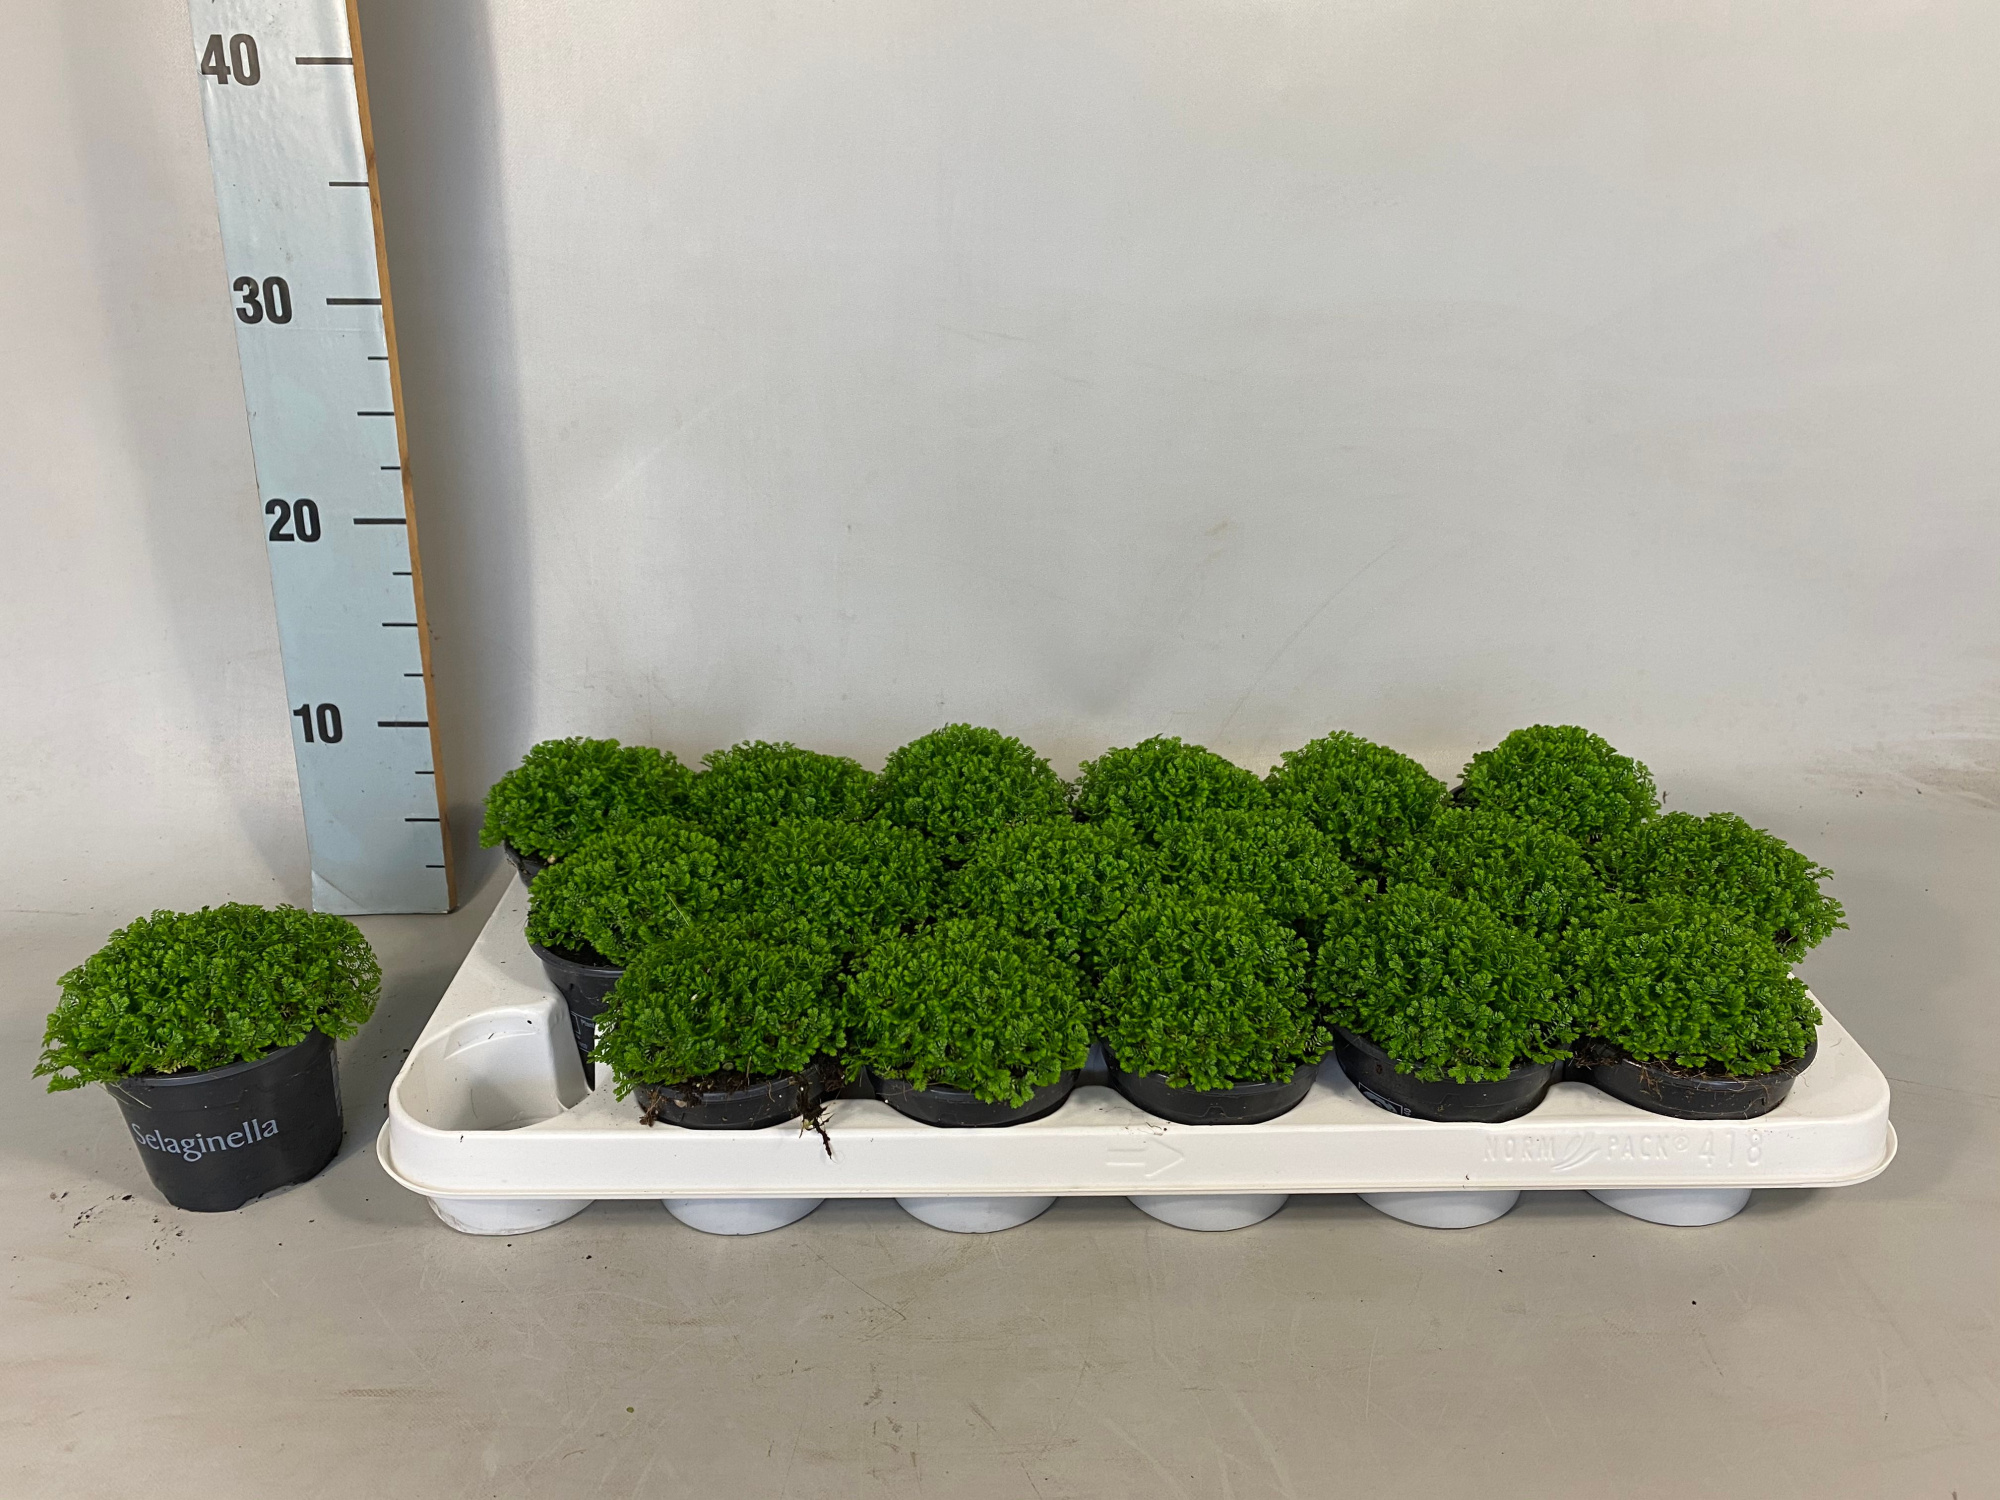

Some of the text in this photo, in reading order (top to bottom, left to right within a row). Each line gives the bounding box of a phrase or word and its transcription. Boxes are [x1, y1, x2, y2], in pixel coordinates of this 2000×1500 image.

[200, 33, 261, 86] 40
[233, 276, 292, 324] 30
[265, 498, 321, 542] 20
[293, 702, 343, 743] 10
[131, 1118, 279, 1162] Selaginella
[1483, 1134, 1556, 1162] NORM
